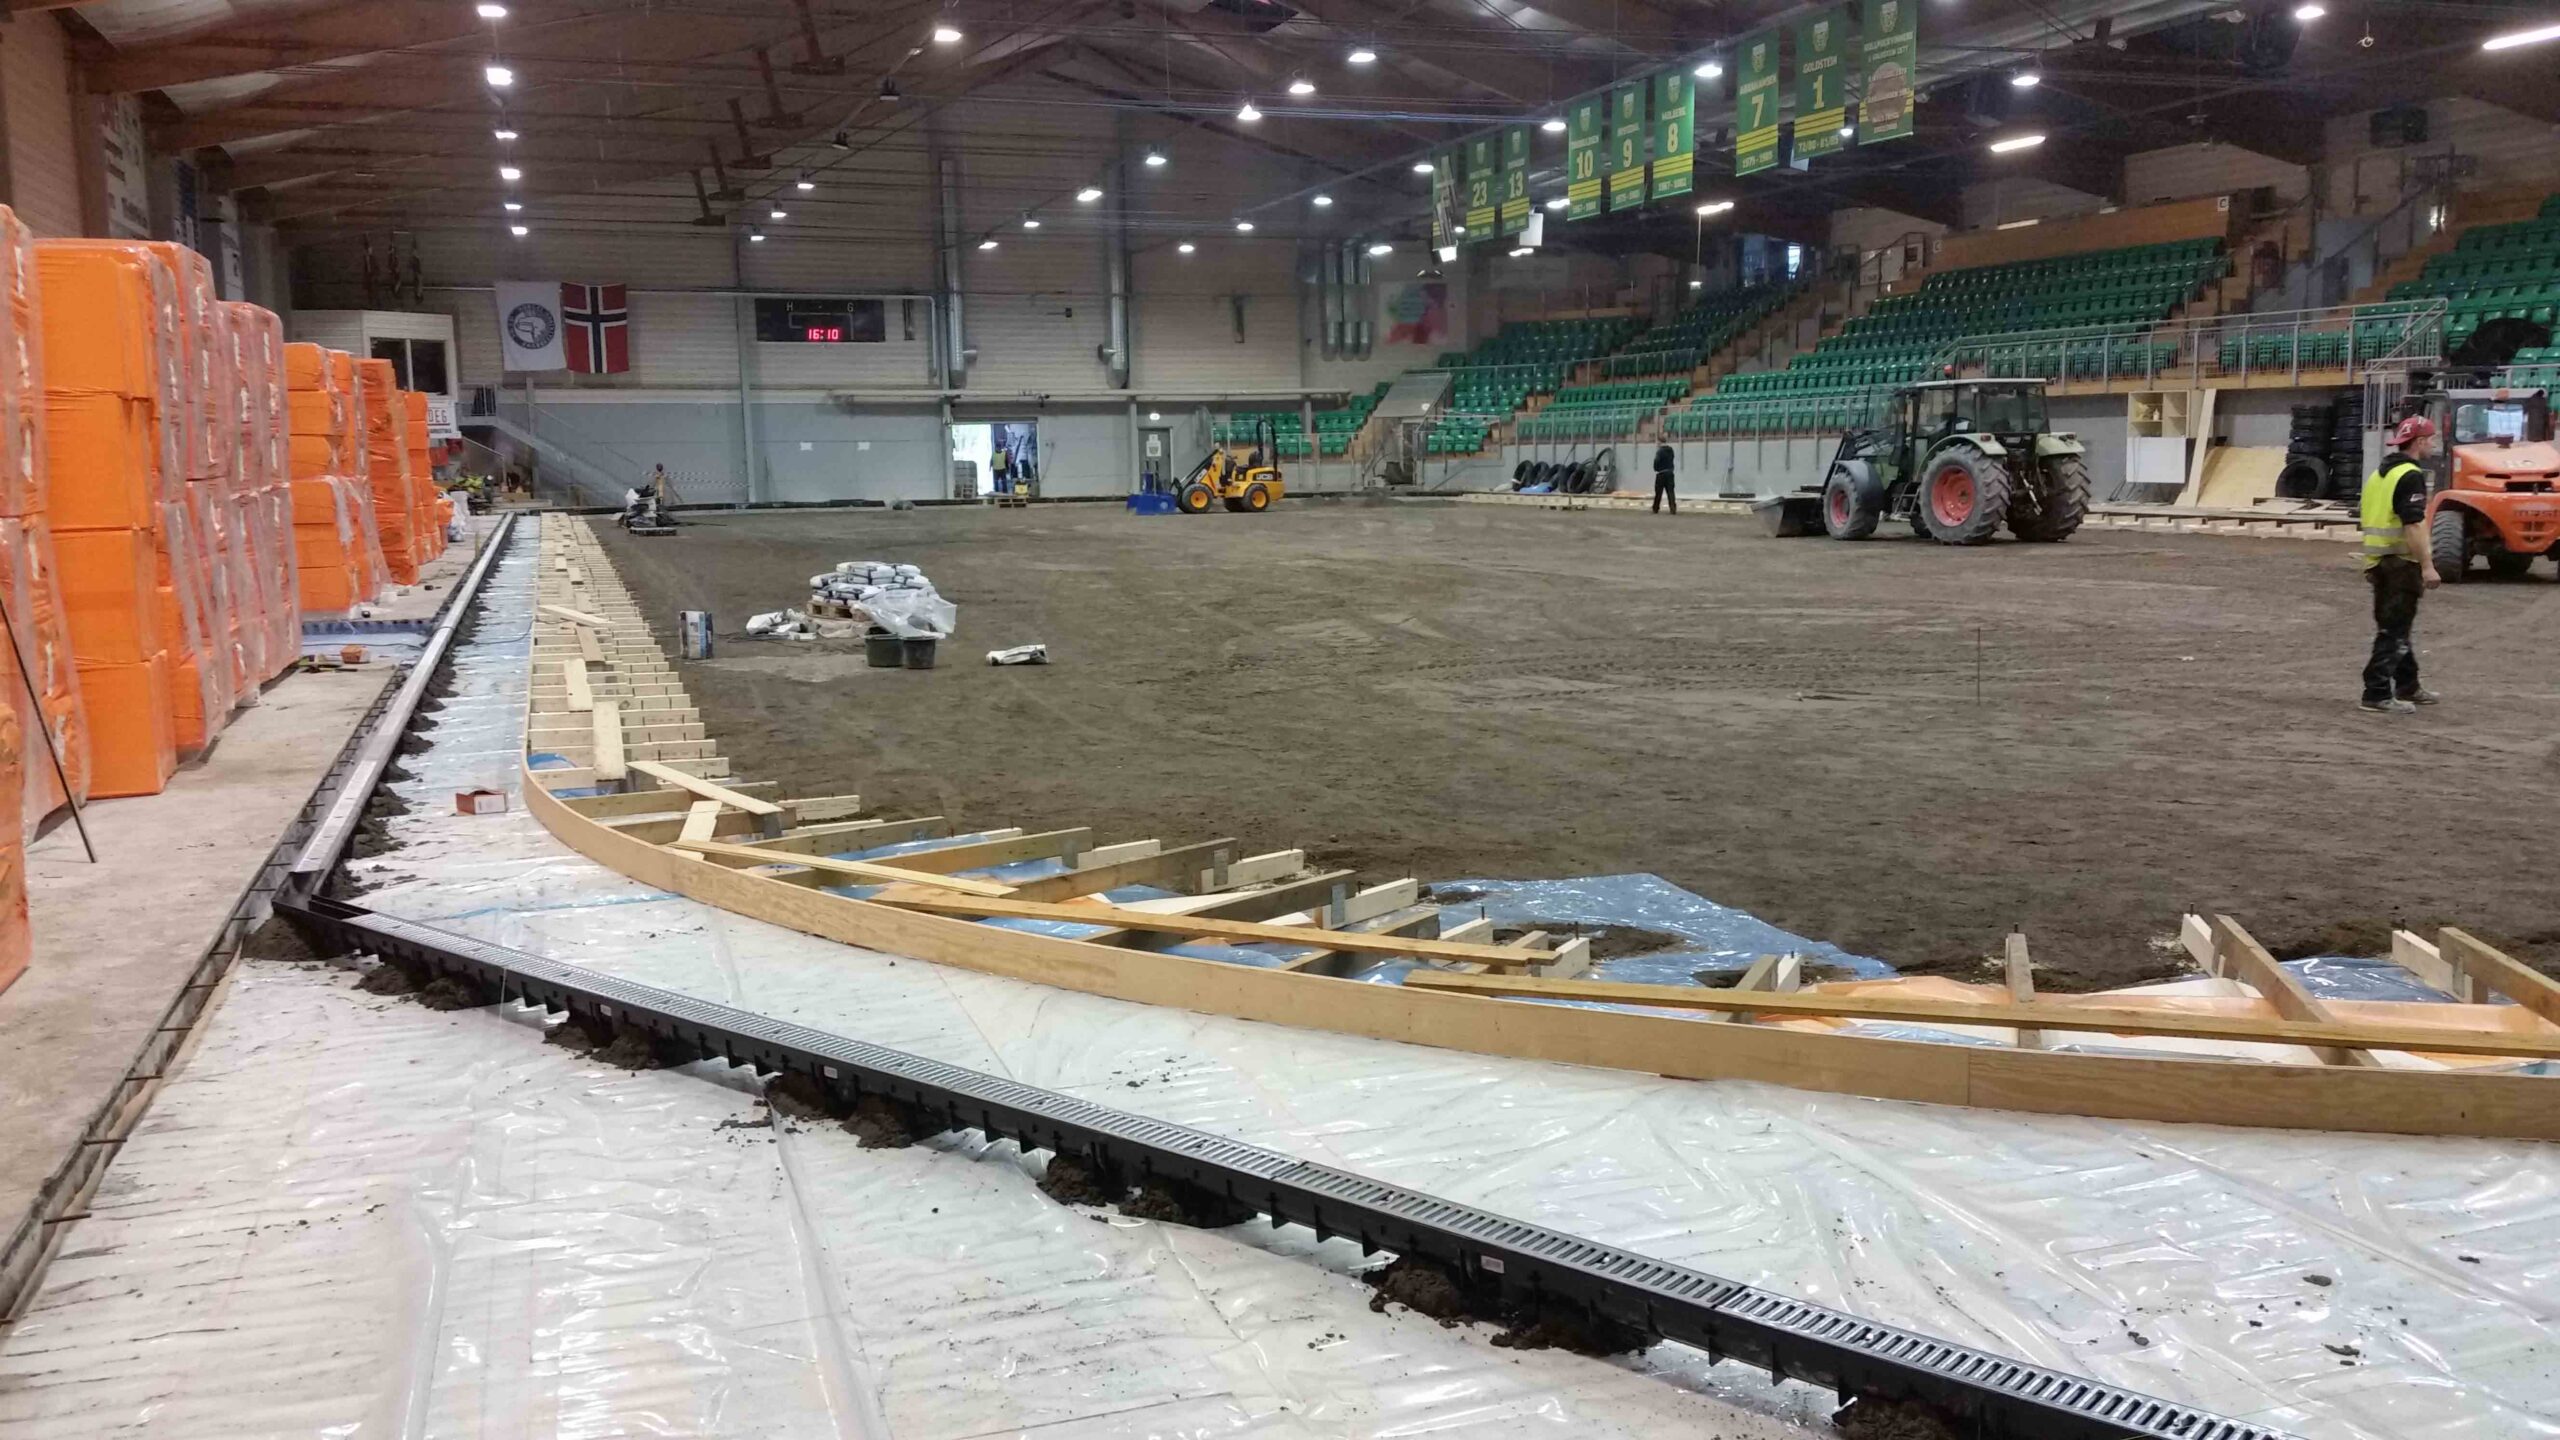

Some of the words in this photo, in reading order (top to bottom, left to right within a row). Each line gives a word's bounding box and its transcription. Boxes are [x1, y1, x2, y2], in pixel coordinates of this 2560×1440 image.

[1803, 56, 1838, 73] GOLDSTEIN
[1813, 74, 1825, 110] 1
[1752, 93, 1764, 128] 7
[1667, 122, 1679, 153] 8
[1576, 149, 1594, 179] 10
[1622, 139, 1633, 168] 9
[1472, 181, 1488, 207] 23
[1508, 171, 1524, 198] 13
[786, 302, 793, 311] H
[847, 302, 854, 312] G
[807, 328, 840, 340] 16:10
